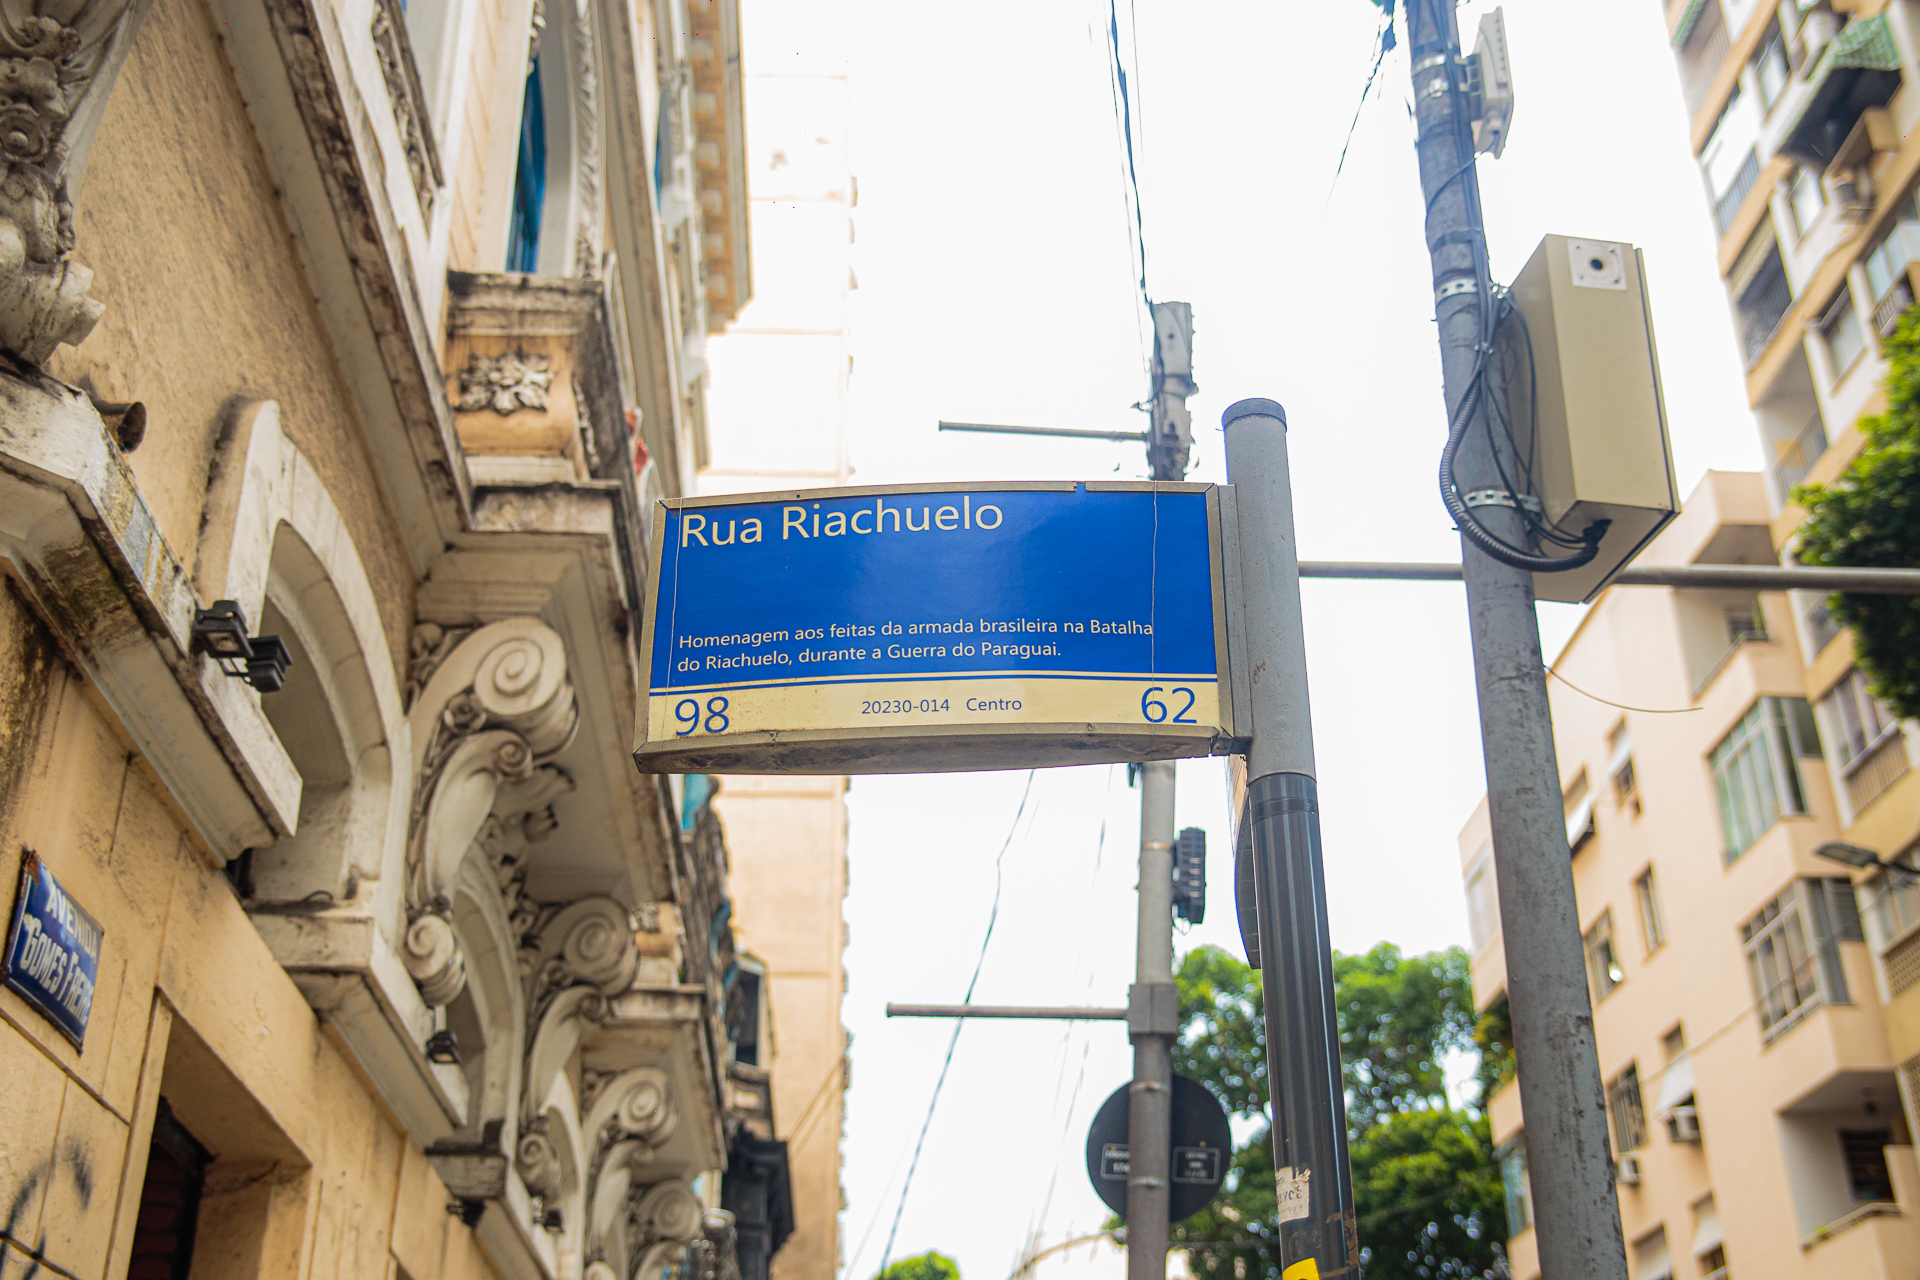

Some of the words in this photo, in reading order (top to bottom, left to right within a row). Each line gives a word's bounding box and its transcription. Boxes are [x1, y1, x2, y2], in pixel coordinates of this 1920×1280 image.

[680, 513, 764, 549] Rua
[782, 495, 1004, 541] Riachuelo
[678, 656, 701, 672] do
[706, 650, 793, 670] Riachuelo,
[798, 646, 867, 663] durante
[872, 648, 882, 660] a
[887, 643, 947, 660] Guerra
[952, 642, 976, 657] do
[980, 642, 1062, 660] Paraguai.
[679, 630, 789, 649] Homenagem
[795, 628, 825, 641] aos
[829, 622, 876, 639] feitas
[881, 620, 903, 637] da
[908, 618, 974, 636] armada
[979, 618, 1058, 634] brasileira
[1064, 622, 1084, 634] na
[1090, 619, 1153, 636] Batalha
[674, 696, 731, 737] 98
[861, 698, 950, 715] 20230-014
[966, 697, 1023, 713] Centro
[1141, 686, 1198, 724] 62
[45, 885, 98, 964] AVENIDA
